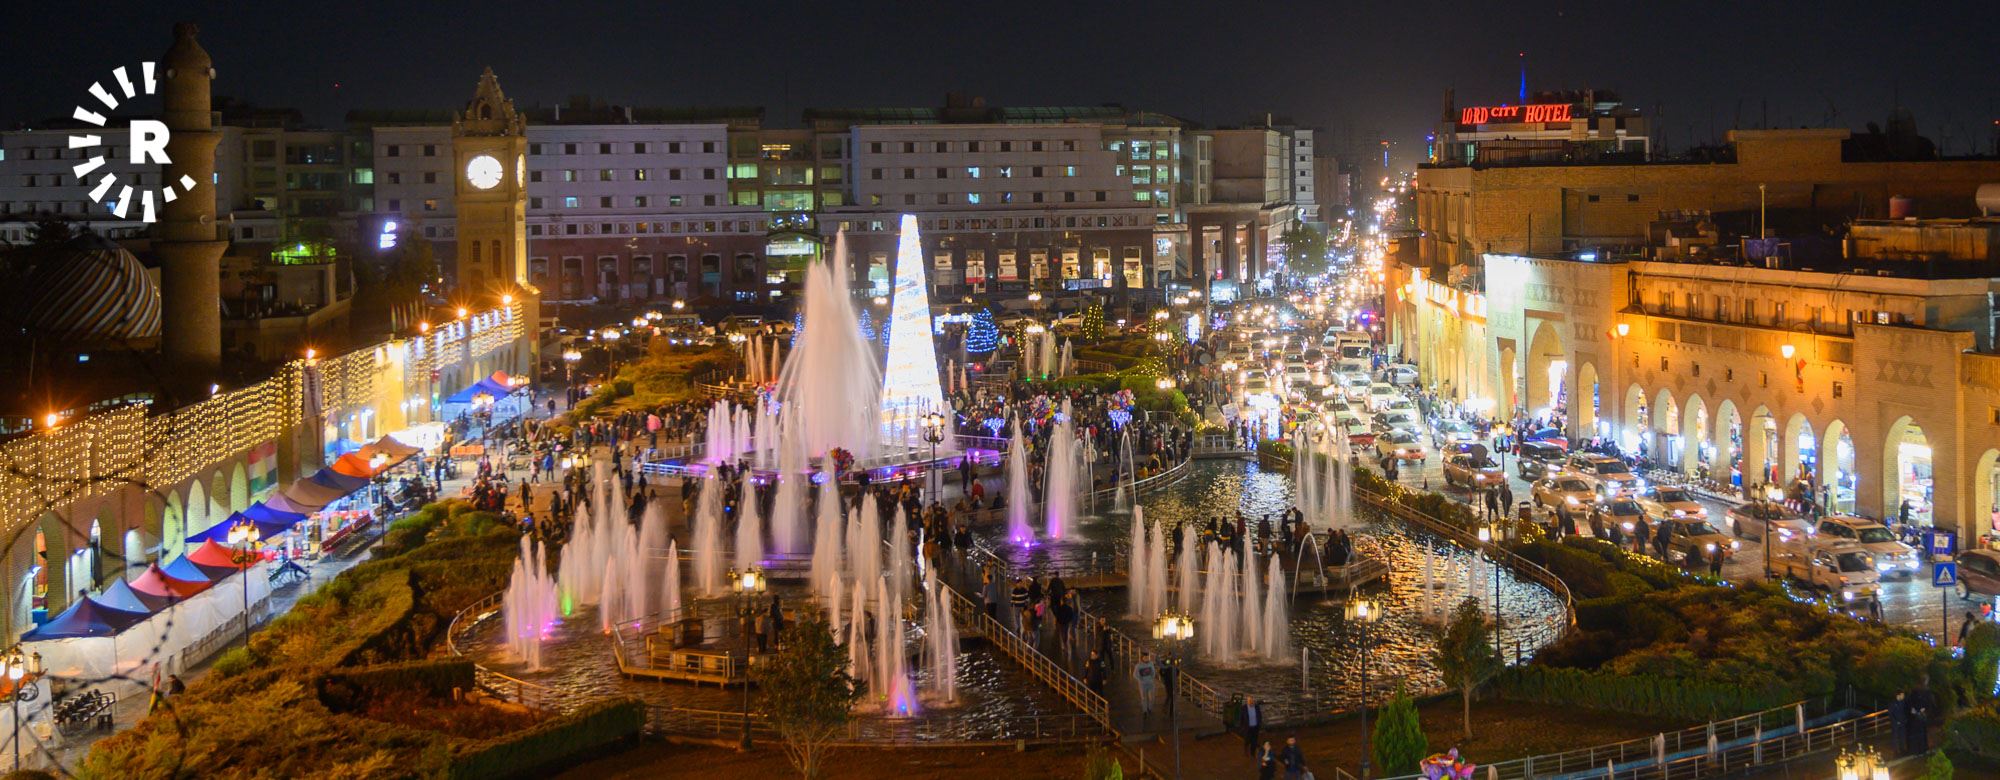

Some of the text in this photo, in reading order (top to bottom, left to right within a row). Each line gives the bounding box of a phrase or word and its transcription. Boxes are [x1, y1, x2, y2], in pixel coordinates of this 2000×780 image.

[1462, 104, 1572, 125] LORD CITY HOTEL
